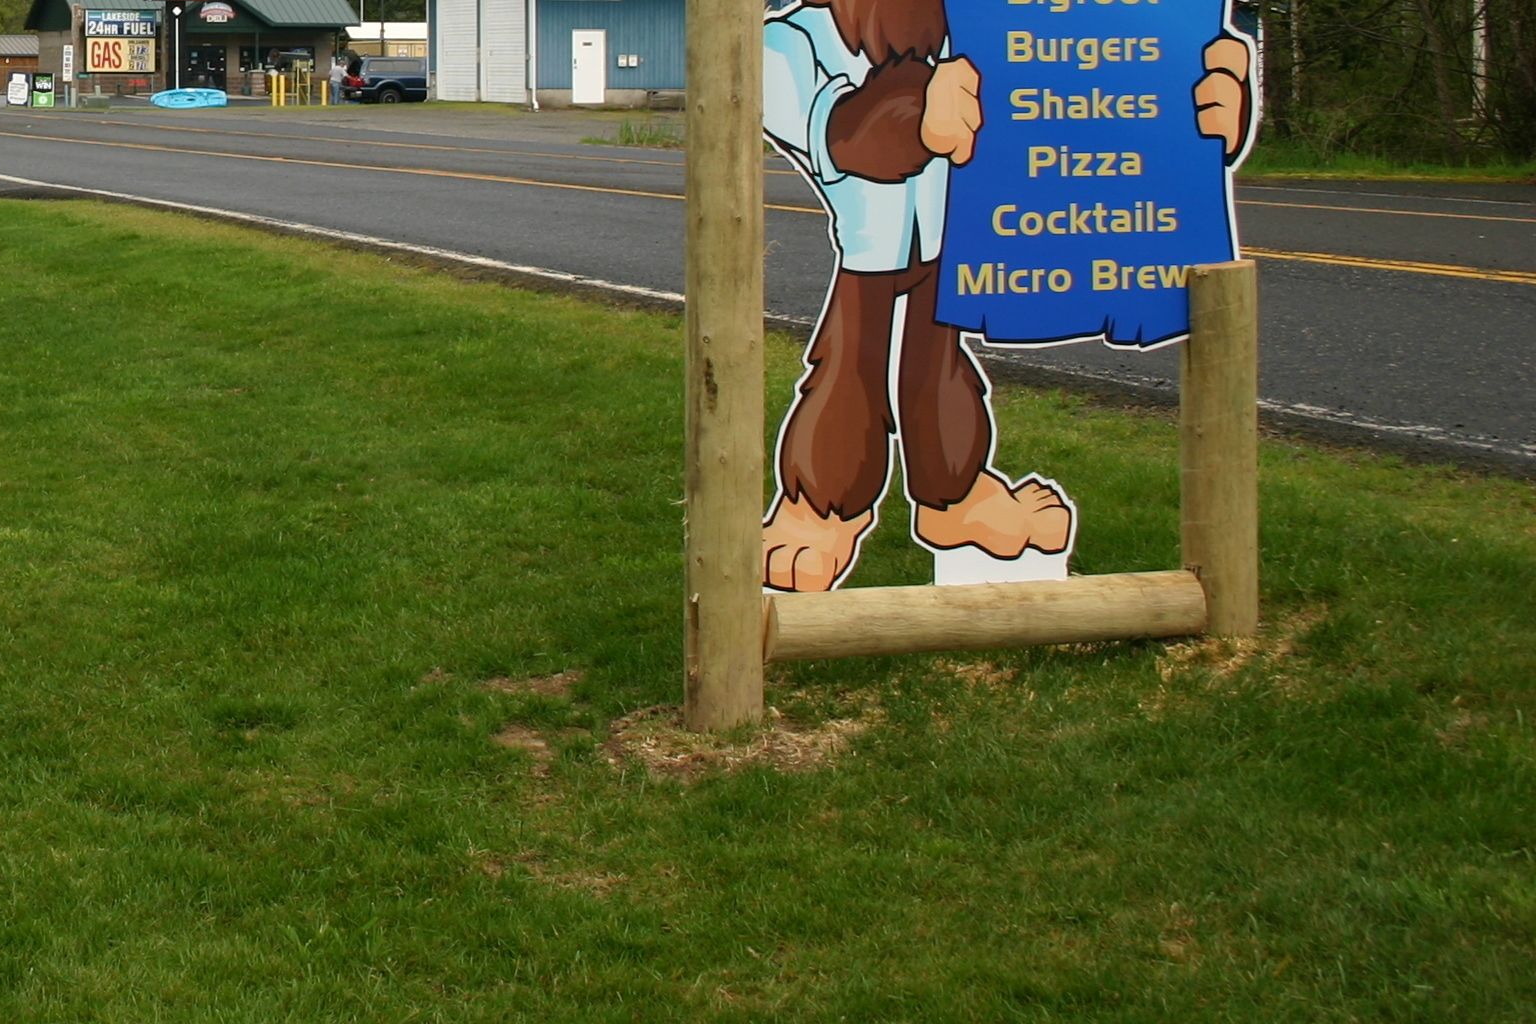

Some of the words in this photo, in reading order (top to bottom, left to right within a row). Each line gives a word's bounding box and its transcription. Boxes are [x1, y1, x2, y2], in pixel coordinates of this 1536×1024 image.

[88, 21, 119, 35] 24HR
[123, 22, 154, 35] FUEL
[101, 12, 140, 21] LAKESIDE
[90, 41, 123, 69] GAS
[1006, 30, 1161, 70] Burgers
[35, 81, 52, 90] WIN
[1009, 88, 1160, 122] Shakes
[1027, 145, 1143, 178] Pizza
[991, 201, 1178, 237] Cocktails
[956, 262, 1073, 296] Micro
